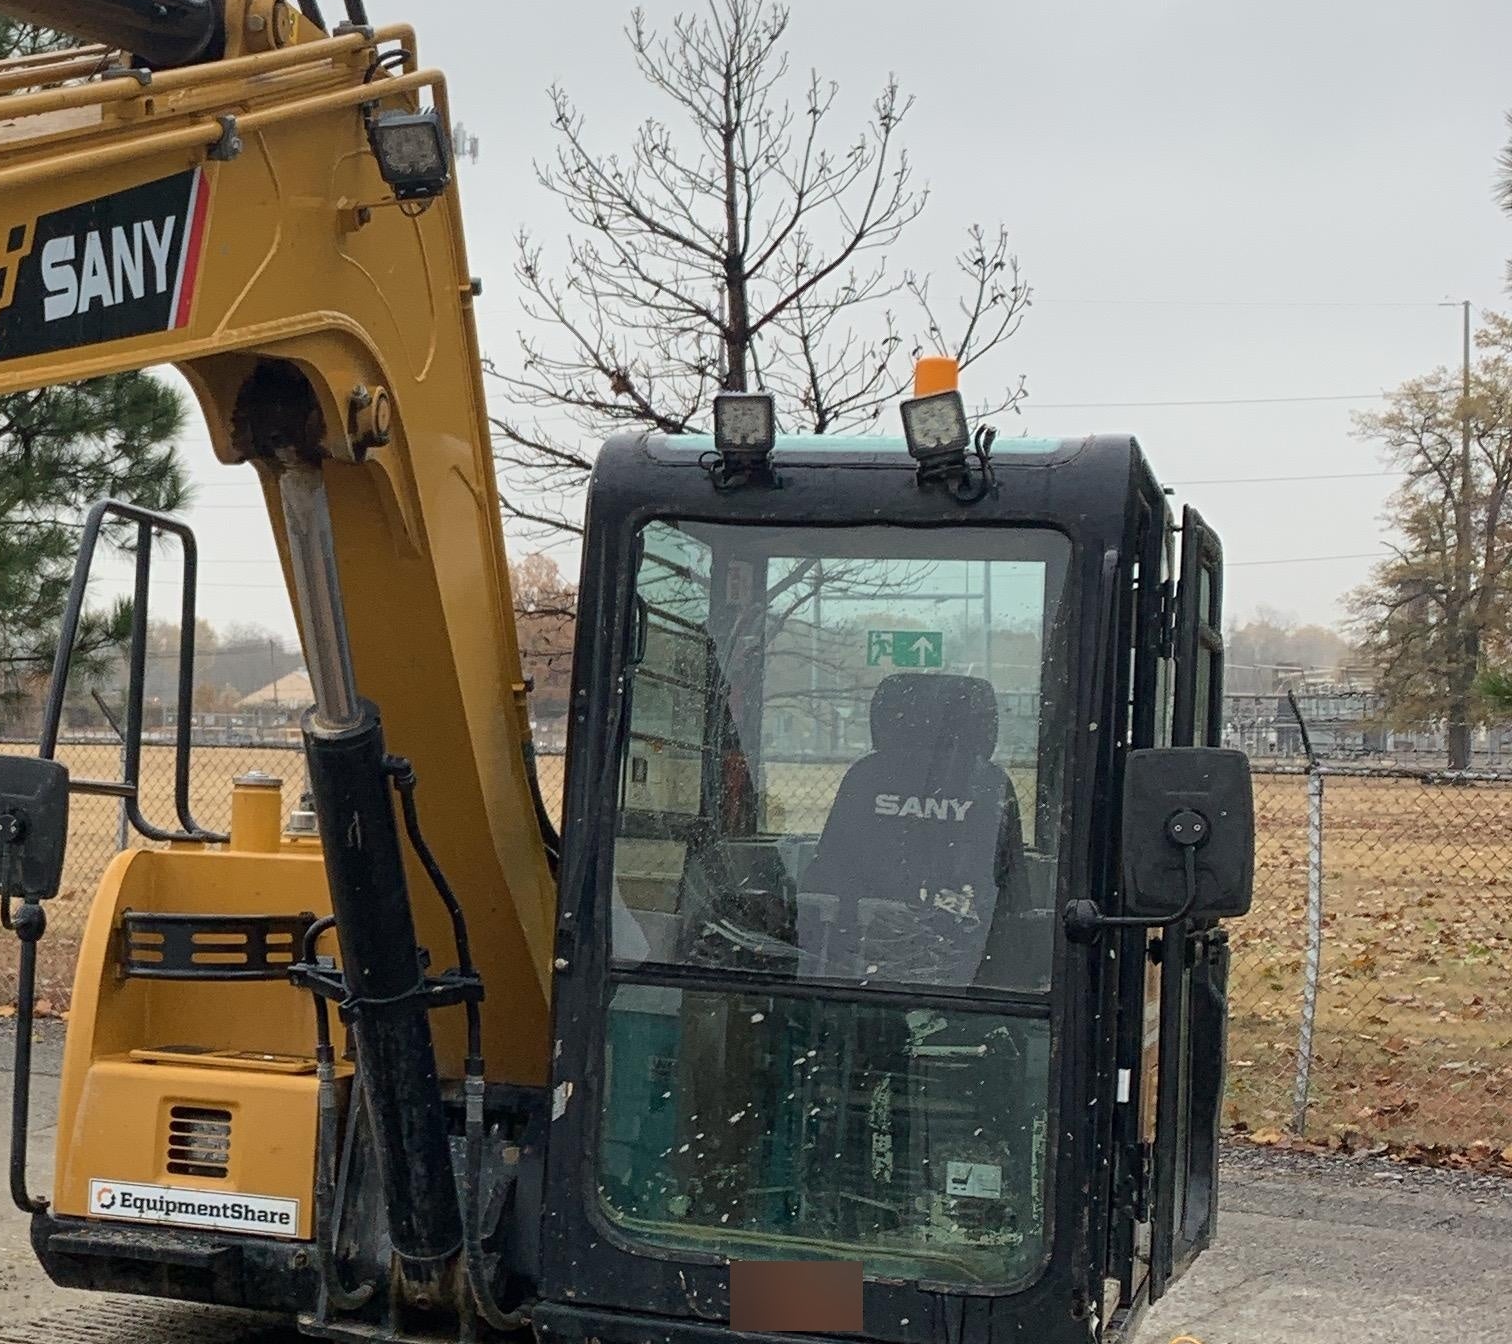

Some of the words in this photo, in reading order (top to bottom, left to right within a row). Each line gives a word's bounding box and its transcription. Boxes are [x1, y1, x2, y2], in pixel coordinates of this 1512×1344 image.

[41, 215, 176, 322] SANY
[874, 794, 974, 821] SANY
[119, 1192, 290, 1225] EquipmentShare
